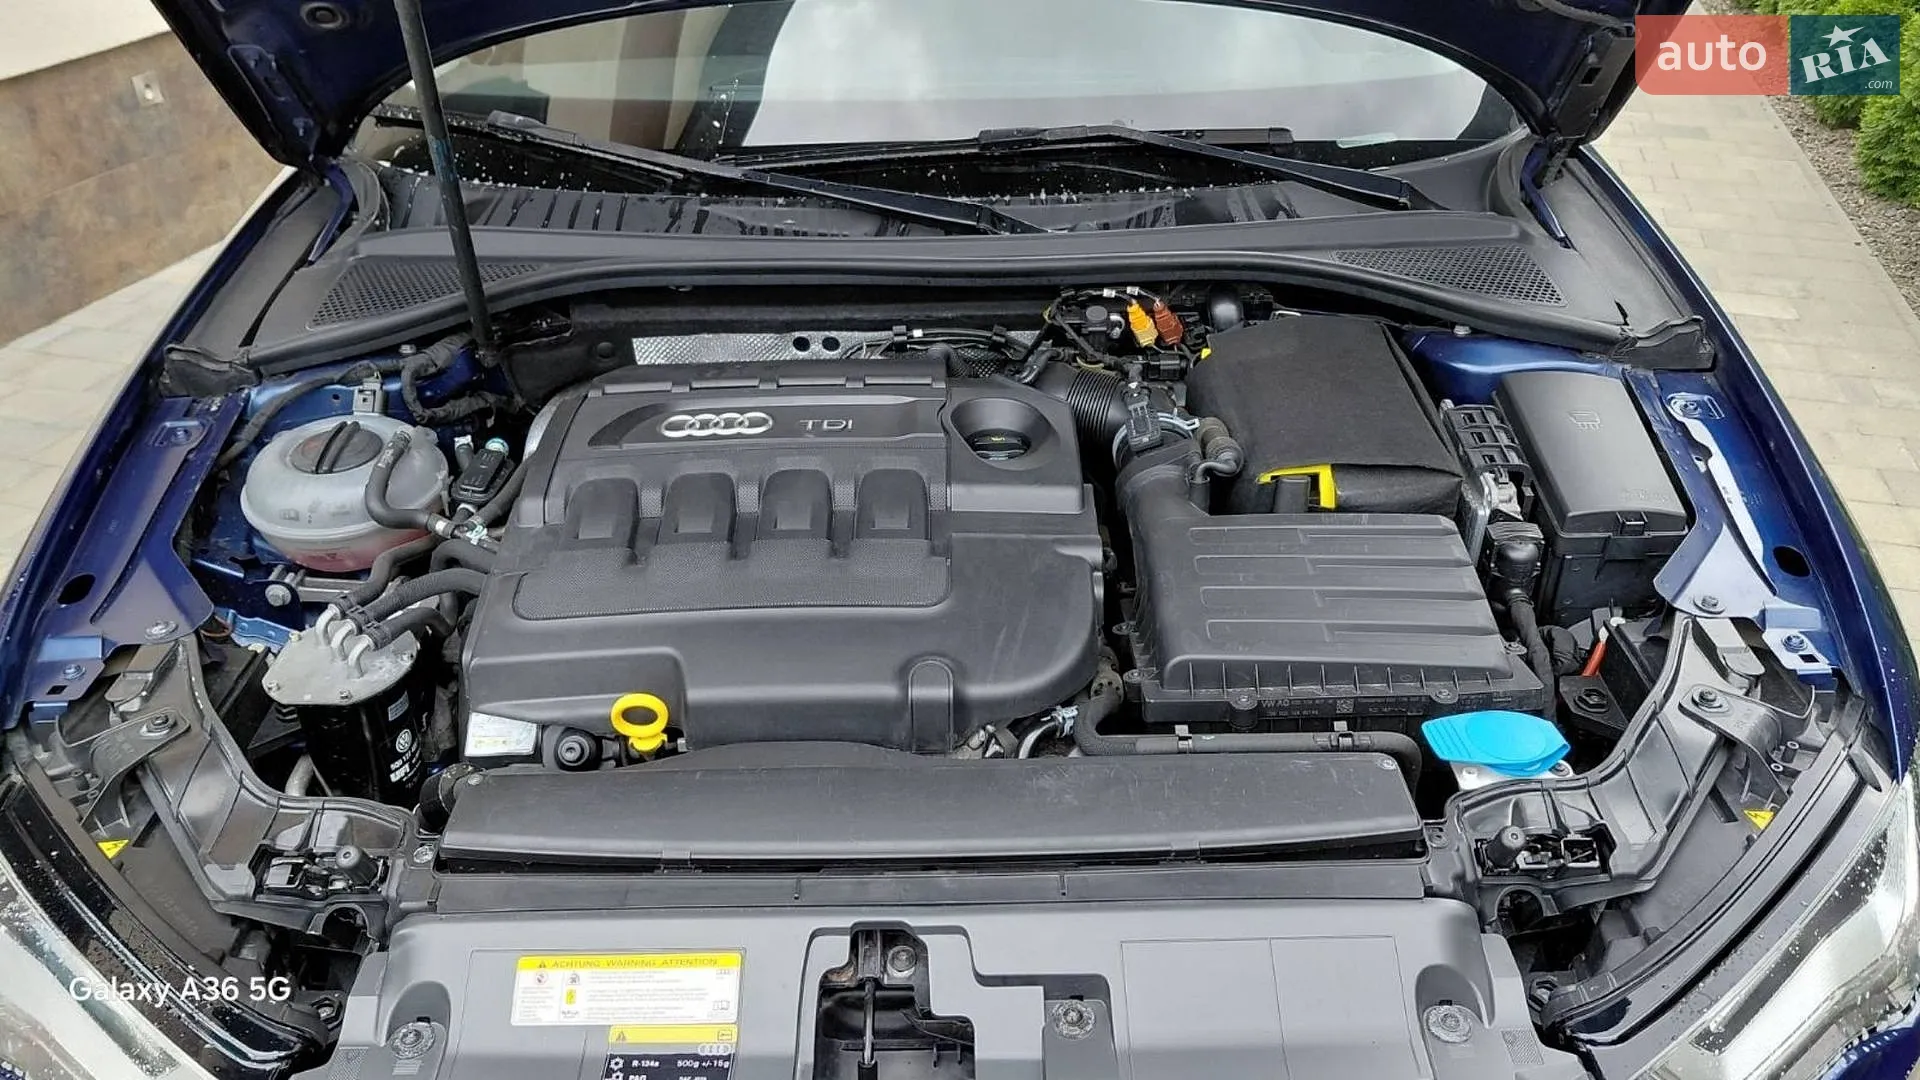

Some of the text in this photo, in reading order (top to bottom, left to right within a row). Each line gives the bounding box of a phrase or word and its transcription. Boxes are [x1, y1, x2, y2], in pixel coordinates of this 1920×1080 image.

[800, 418, 853, 431] TDI
[551, 957, 718, 968] ACHTUNG WARNING ATTENTION
[677, 1060, 700, 1069] 500g
